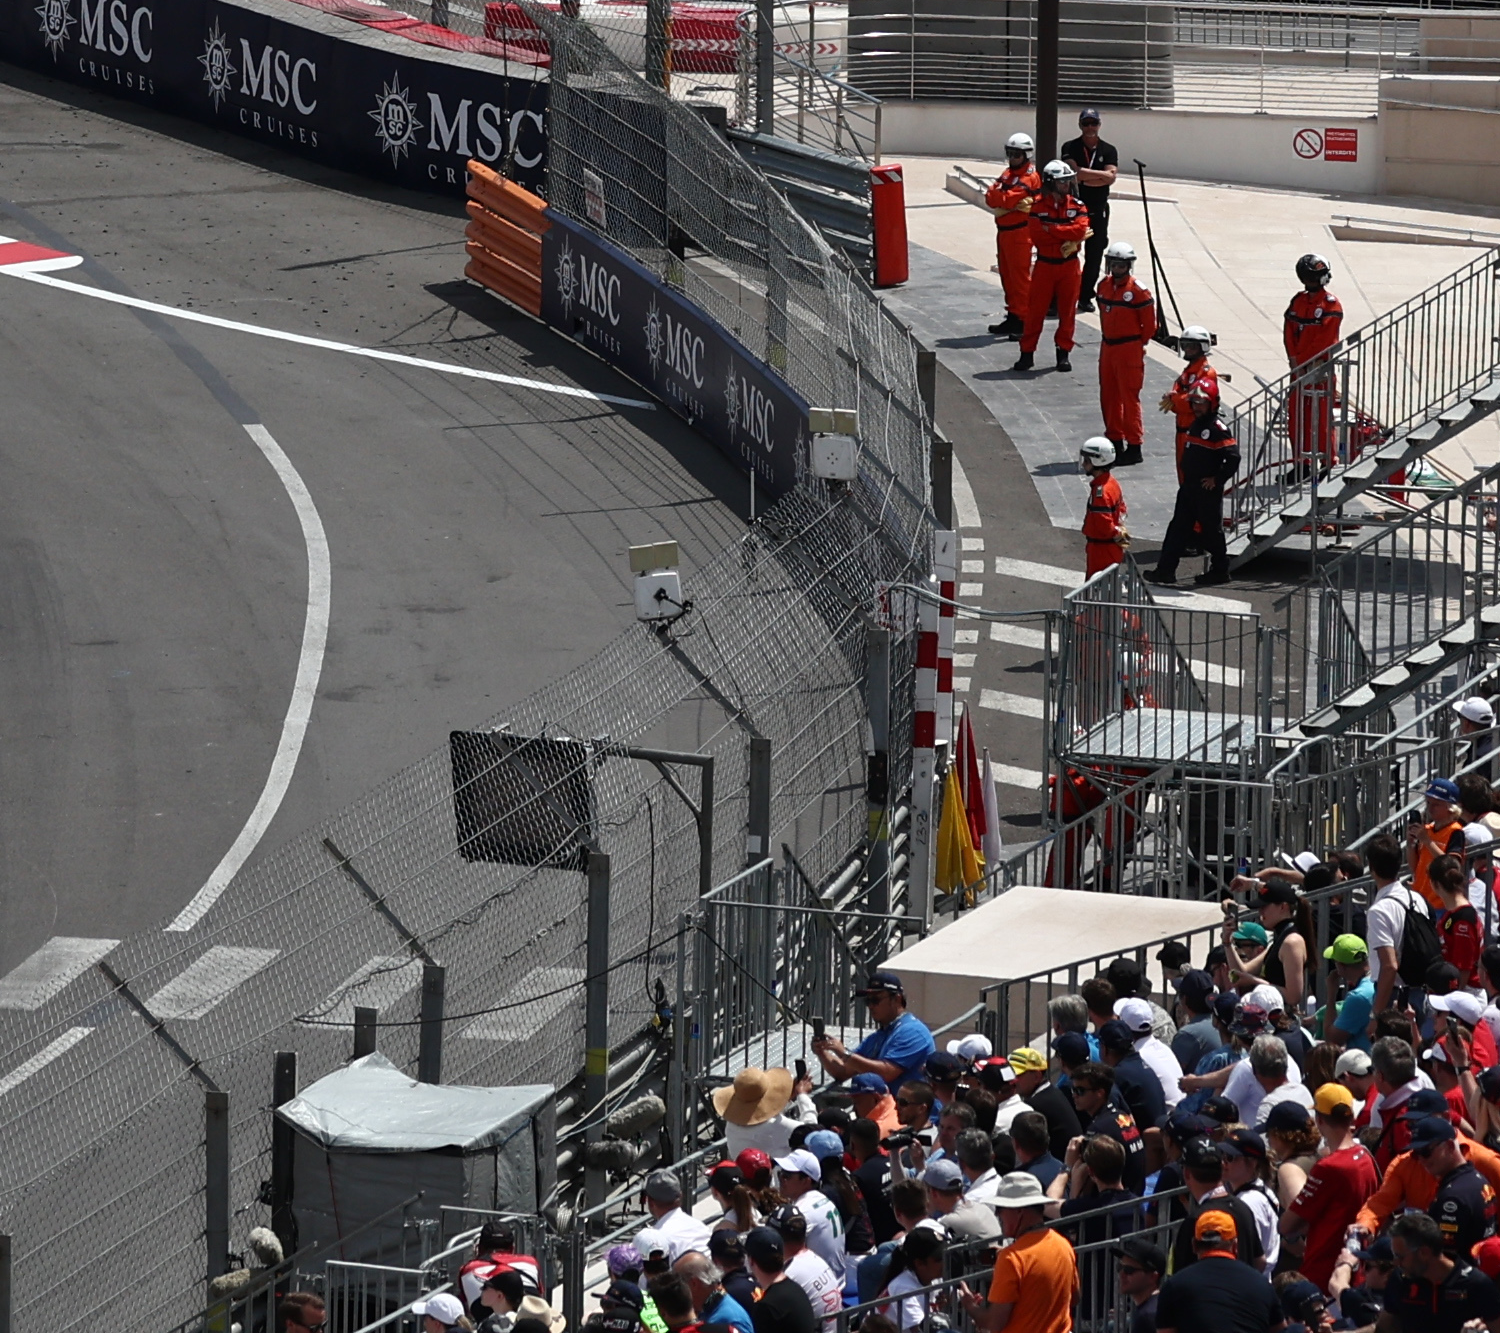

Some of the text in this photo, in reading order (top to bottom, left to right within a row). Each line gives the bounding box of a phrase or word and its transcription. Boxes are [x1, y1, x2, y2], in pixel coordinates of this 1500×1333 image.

[79, 57, 155, 96] CRUISES
[240, 38, 318, 116] MSC
[240, 107, 318, 149] CRUISES
[426, 91, 545, 169] MSC
[579, 255, 621, 327] MSC
[665, 314, 705, 389] MSC
[742, 377, 775, 453] MSC
